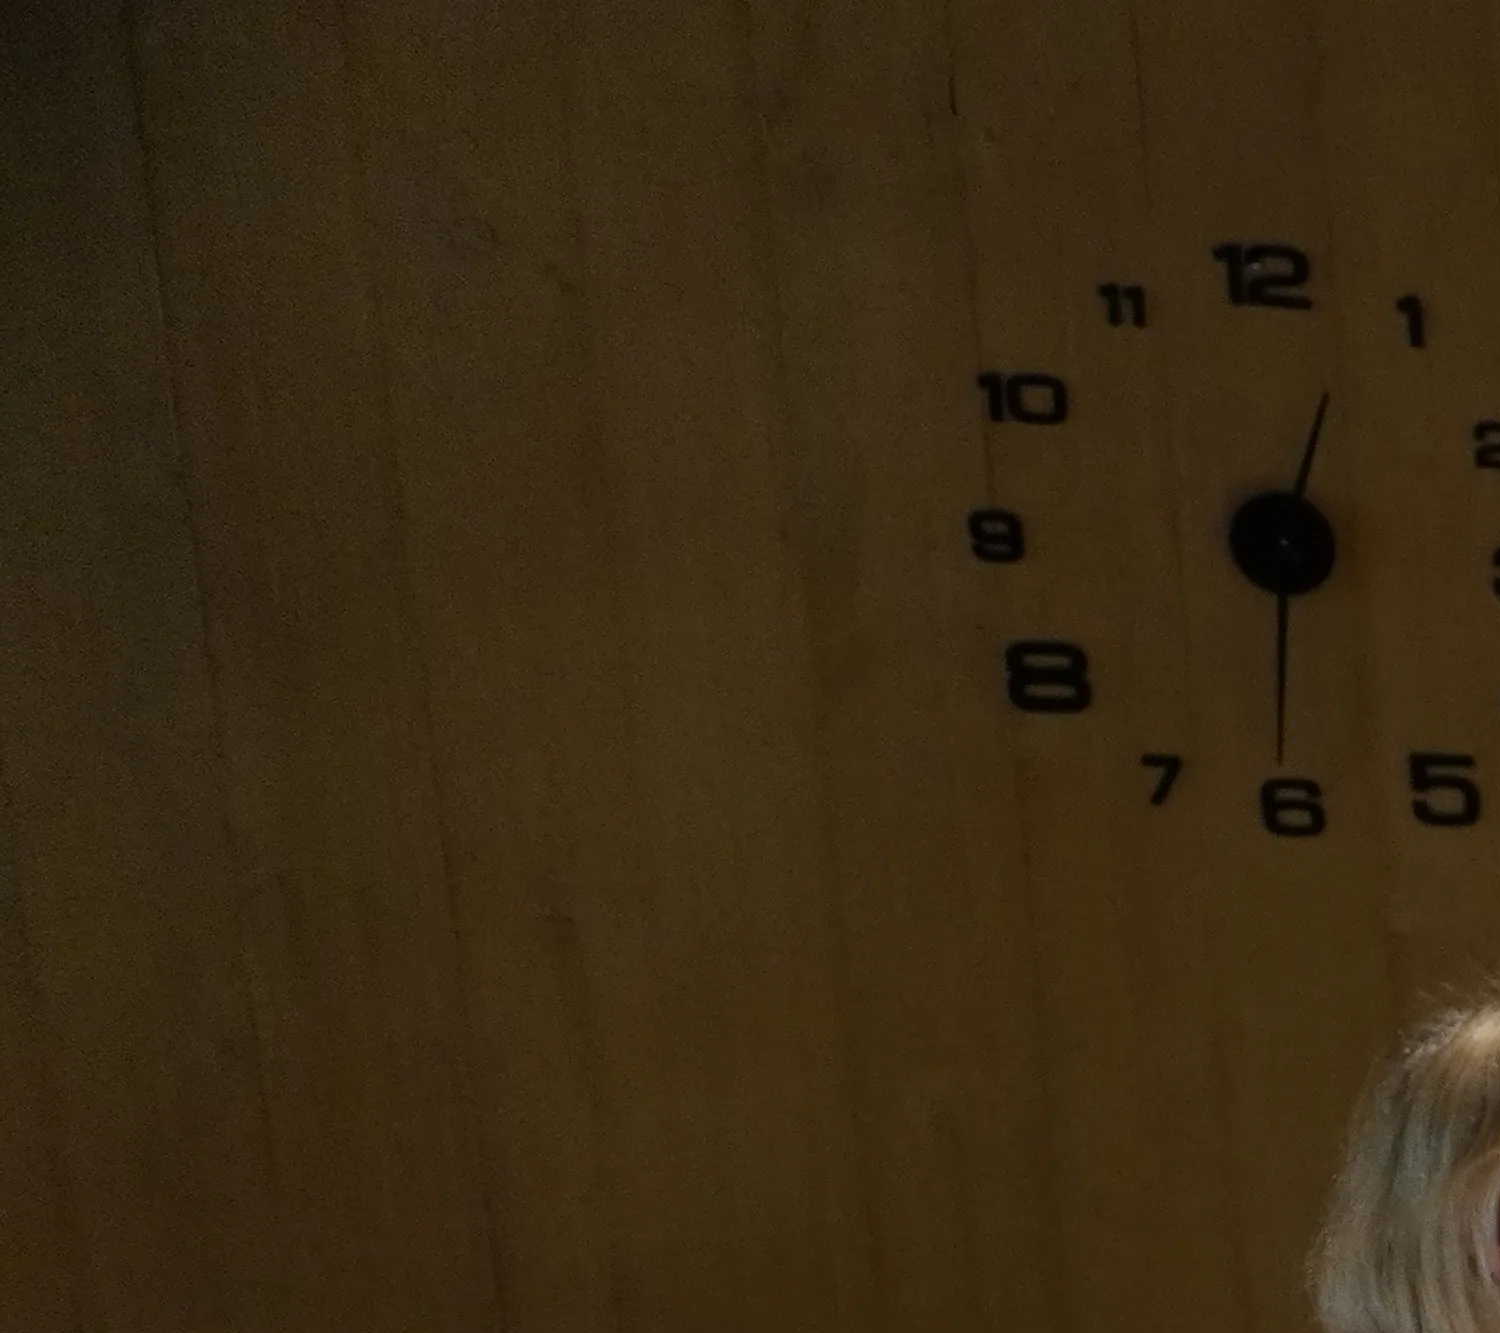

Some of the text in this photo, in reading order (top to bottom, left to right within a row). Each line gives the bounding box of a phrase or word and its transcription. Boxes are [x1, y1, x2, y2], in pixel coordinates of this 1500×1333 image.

[1213, 244, 1313, 311] 12
[1097, 283, 1146, 328] 11
[1397, 294, 1425, 348] 1
[977, 372, 1069, 425] 10
[967, 509, 1025, 563] 9
[1004, 640, 1092, 714] 8
[1141, 754, 1182, 805] 7
[1407, 752, 1481, 827] 5
[1259, 778, 1326, 837] 6
